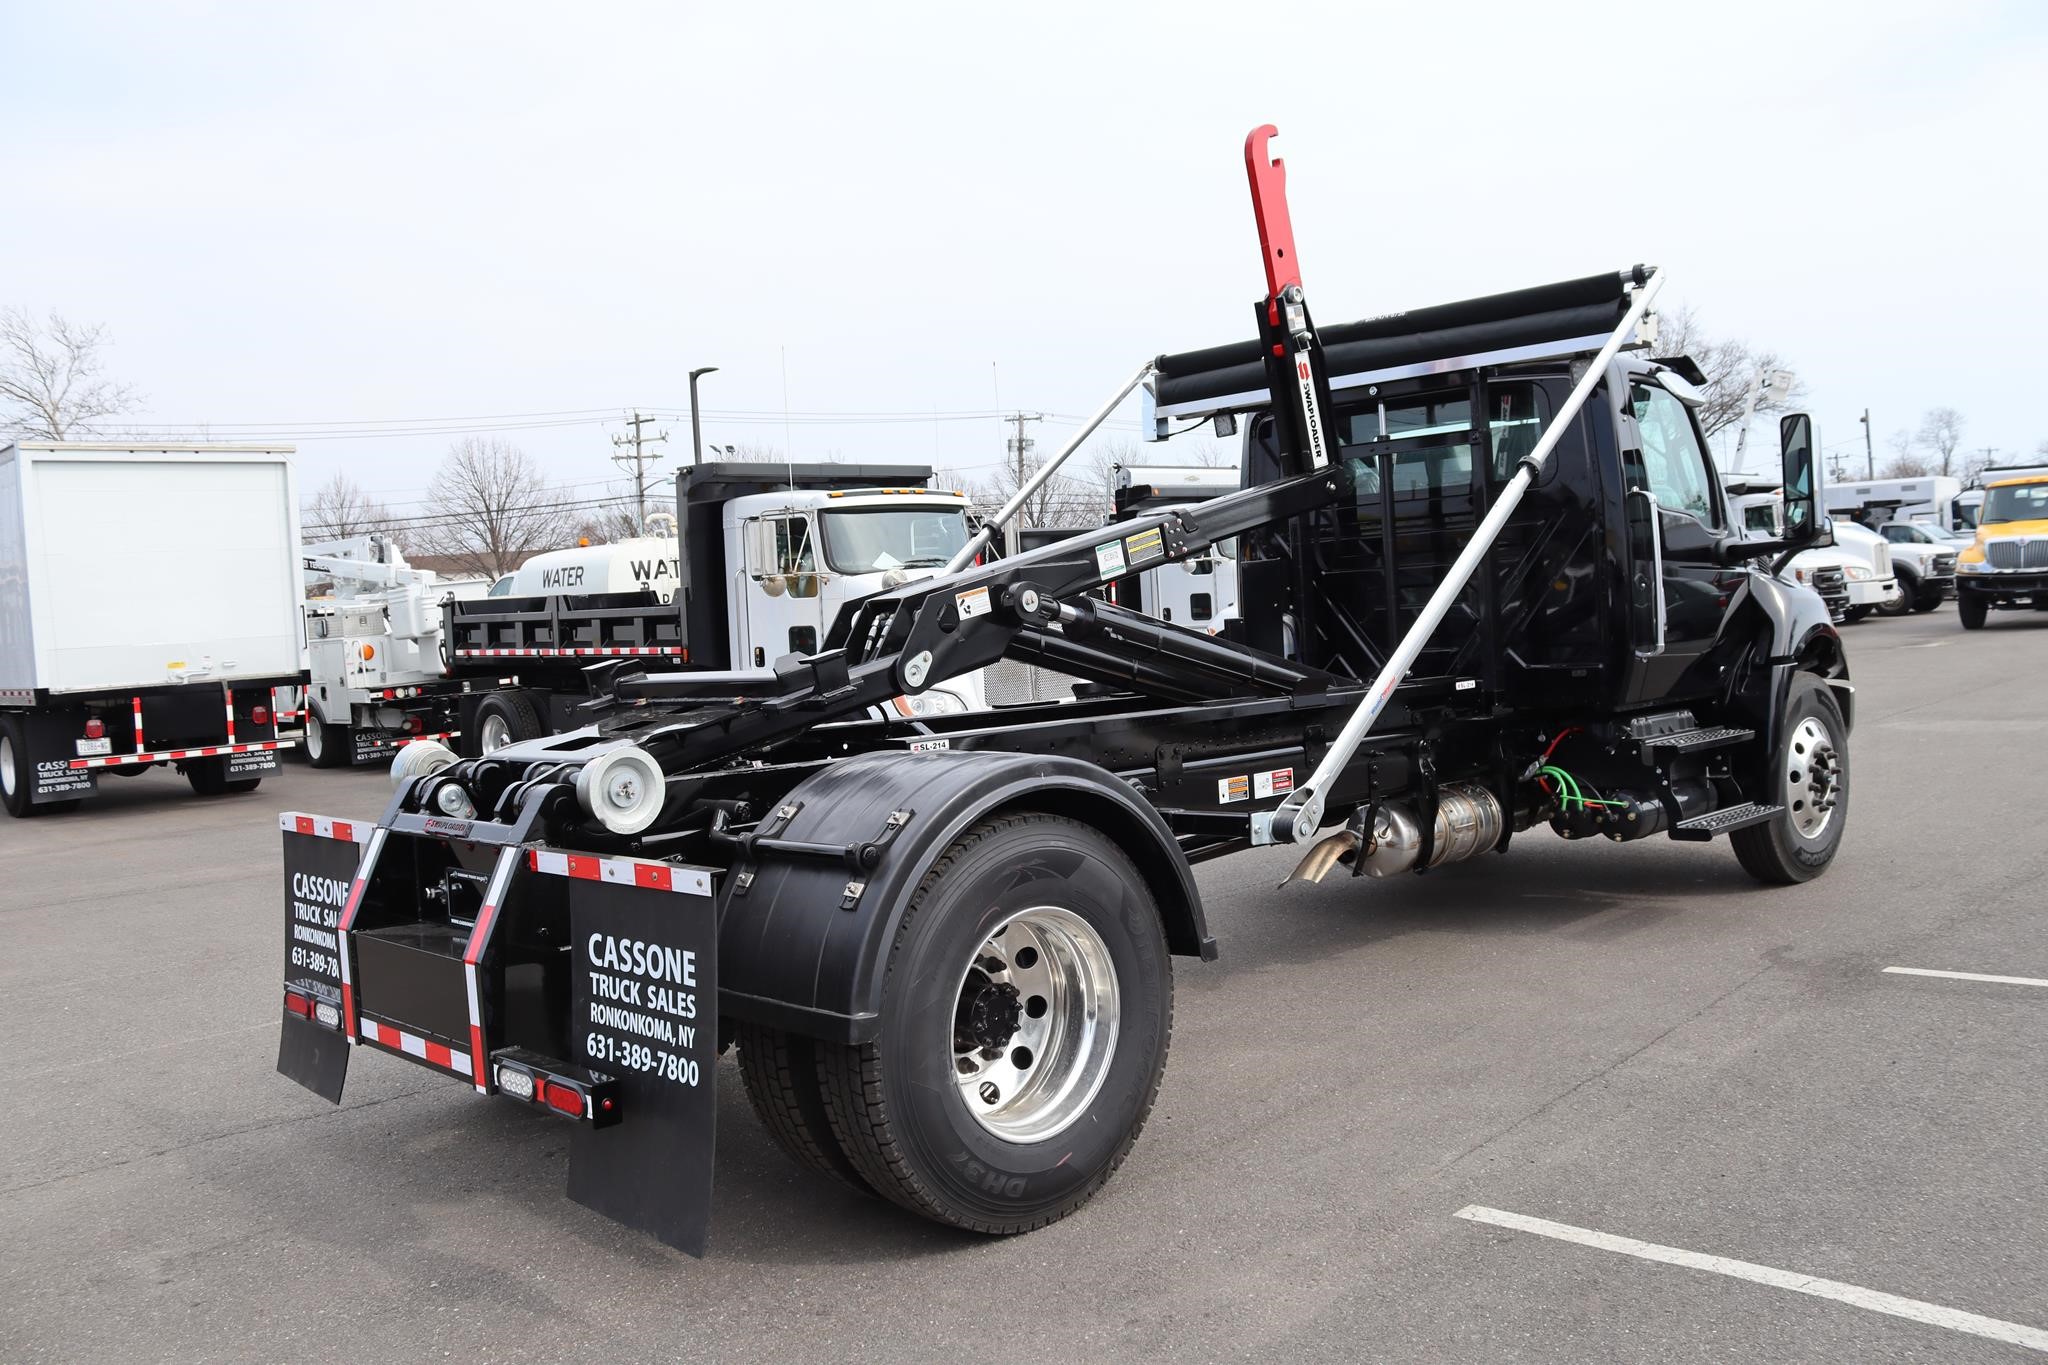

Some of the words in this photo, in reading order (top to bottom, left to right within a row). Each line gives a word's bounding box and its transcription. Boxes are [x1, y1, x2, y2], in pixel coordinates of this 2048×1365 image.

[1302, 383, 1322, 458] SWAPLOADER
[542, 566, 584, 588] WATER
[919, 741, 946, 751] SL-214
[38, 770, 64, 778] TRUCK
[230, 762, 276, 772] 631-389-7800
[38, 781, 91, 793] 631-389-7800
[293, 901, 321, 925] TRUCK
[323, 909, 341, 929] SAL
[294, 923, 337, 953] RONKONKOMA,
[588, 933, 696, 987] CASSONE
[589, 971, 641, 1006] TRUCK
[647, 985, 696, 1019] SALES
[590, 1002, 676, 1047] RONKONKOMA,
[678, 1024, 696, 1049] NY
[587, 1032, 699, 1087] 631-389-7800
